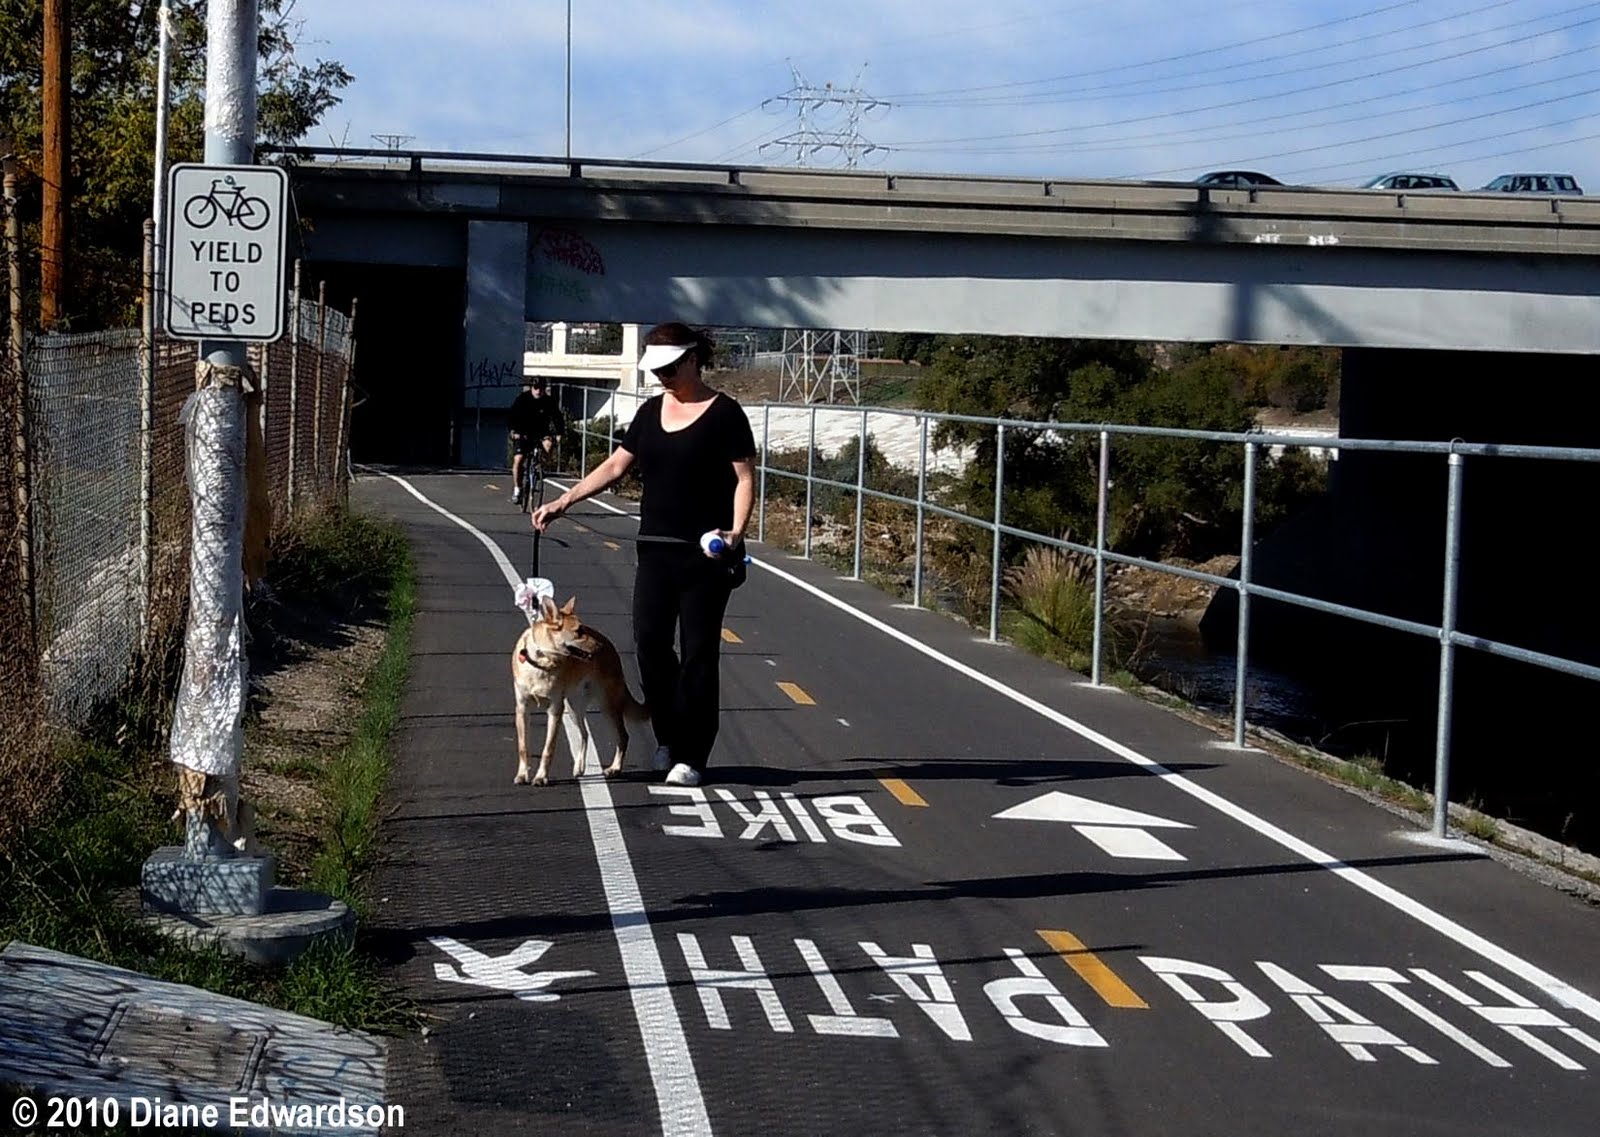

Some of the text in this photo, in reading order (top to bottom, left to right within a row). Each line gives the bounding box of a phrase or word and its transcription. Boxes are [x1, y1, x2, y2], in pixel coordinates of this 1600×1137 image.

[190, 240, 263, 264] YIELD
[209, 270, 241, 293] TO
[190, 301, 256, 325] PEDS
[647, 785, 903, 848] BIKE
[675, 932, 1110, 1048] PATH
[1136, 954, 1600, 1072] PATH
